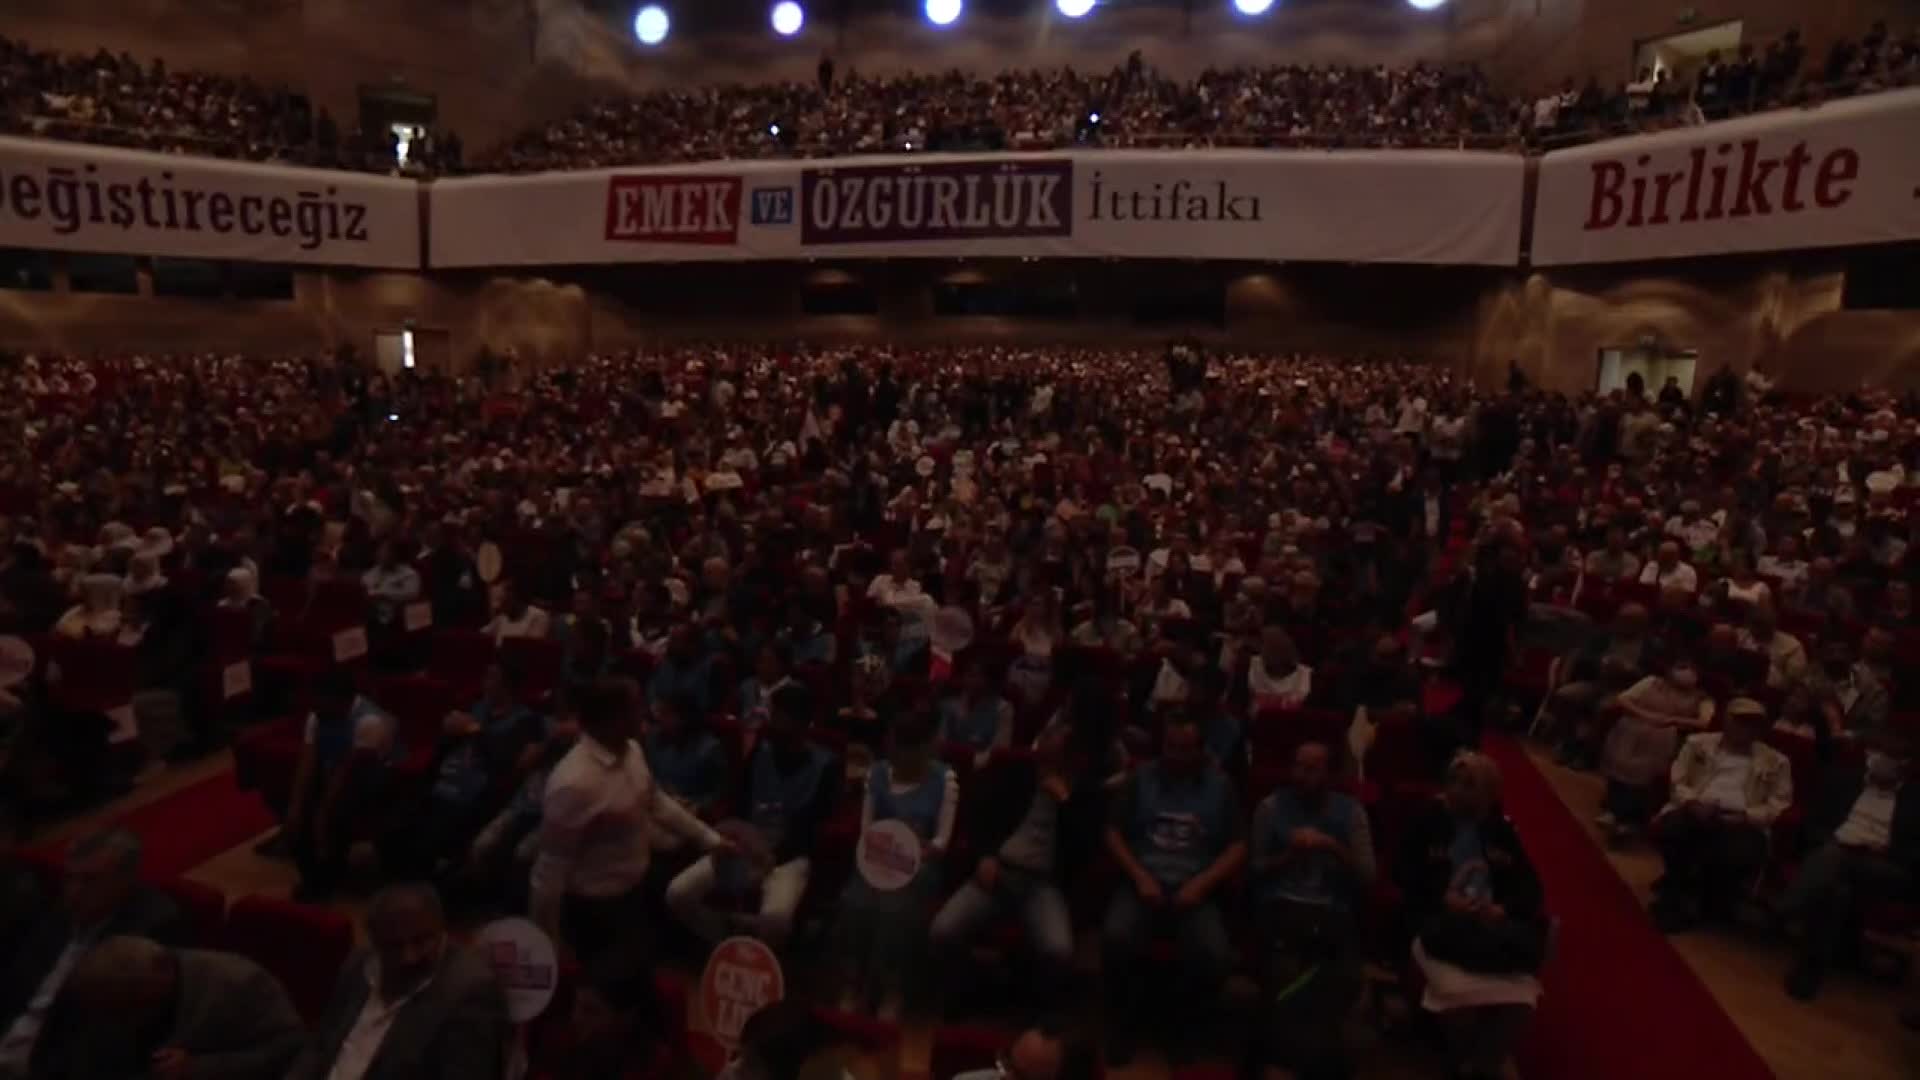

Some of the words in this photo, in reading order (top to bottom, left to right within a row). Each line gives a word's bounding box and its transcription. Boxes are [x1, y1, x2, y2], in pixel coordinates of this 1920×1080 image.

[0, 163, 368, 250] eğiştireceğiz
[613, 181, 734, 236] EMEK
[757, 191, 788, 220] VE
[812, 163, 1062, 230] ÖZGÜRLÜK
[1088, 171, 1263, 221] İttifakı
[1583, 139, 1859, 231] Birlikte
